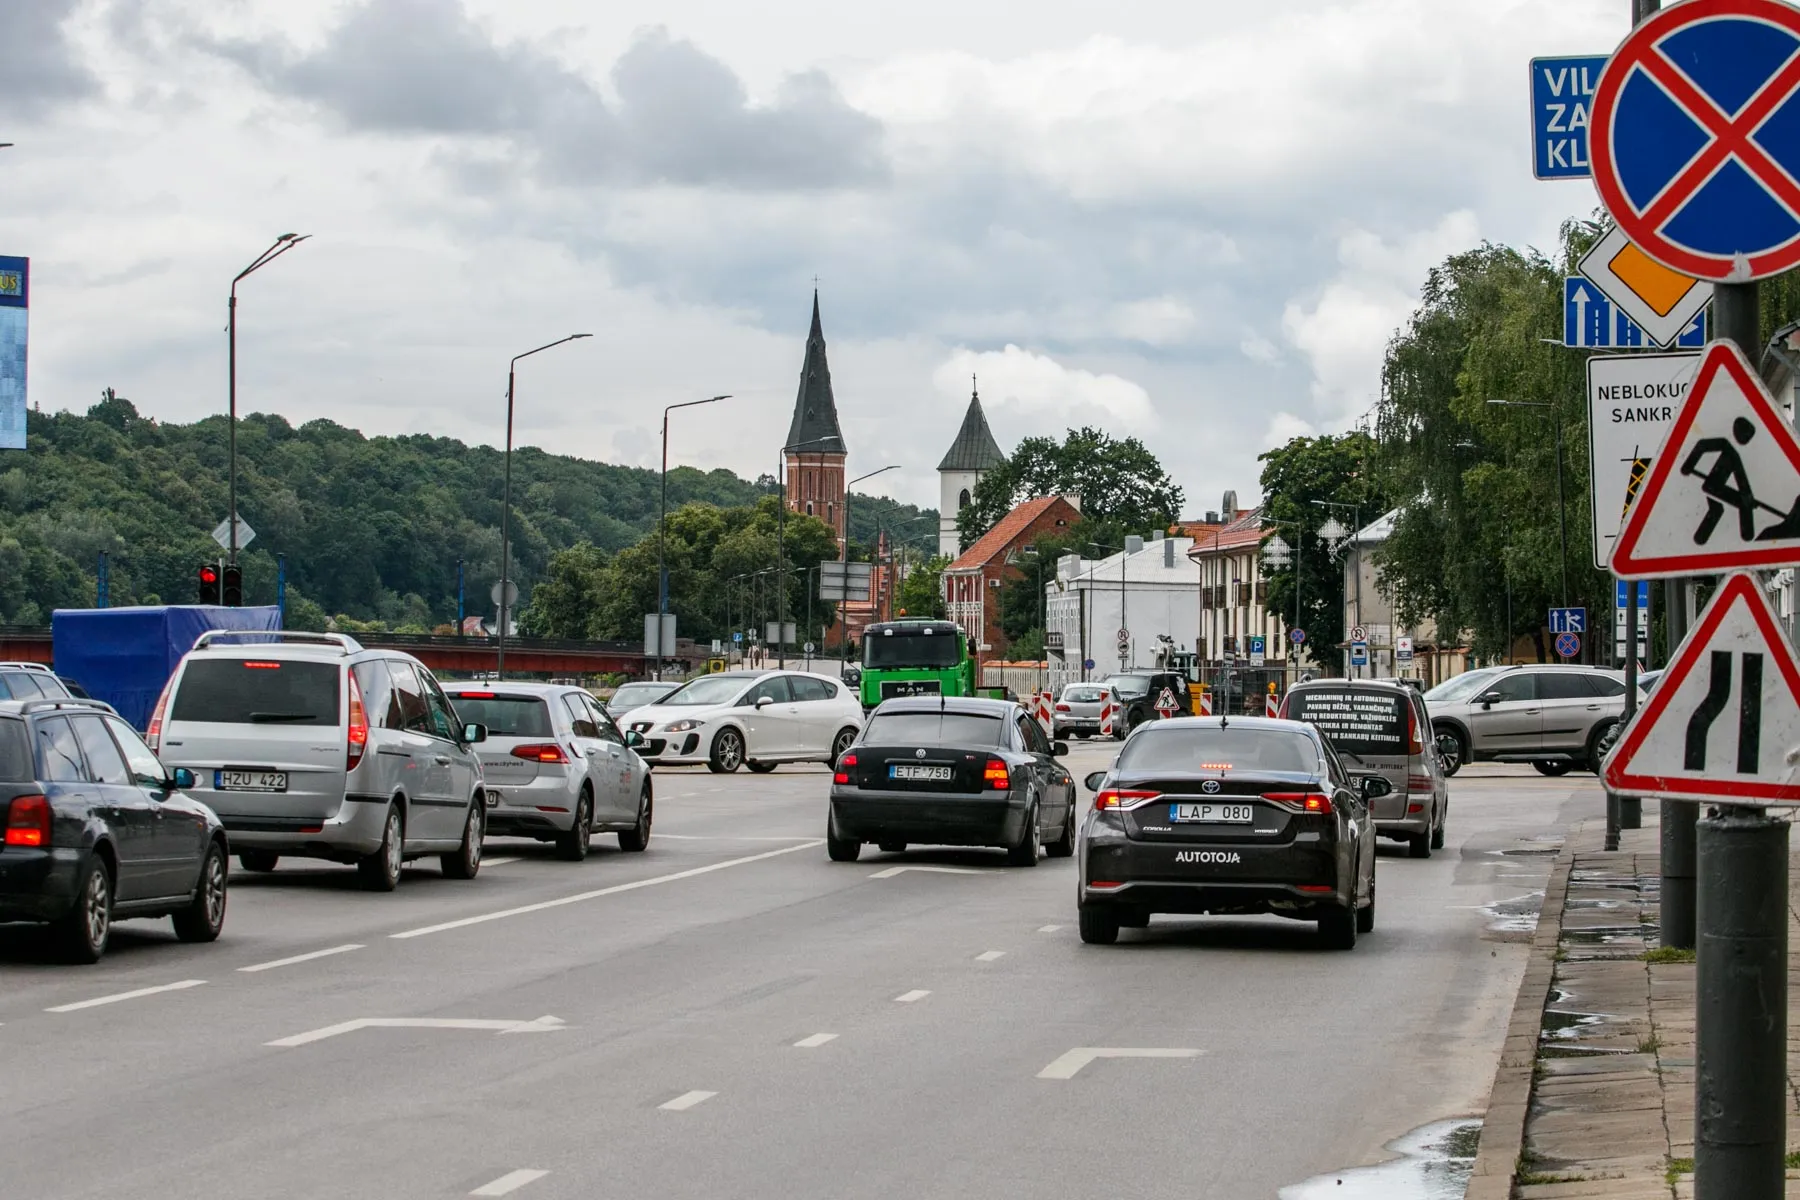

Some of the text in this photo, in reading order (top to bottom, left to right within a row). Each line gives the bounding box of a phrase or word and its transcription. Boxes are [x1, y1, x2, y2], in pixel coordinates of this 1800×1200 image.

[1543, 66, 1595, 97] VIL
[1545, 102, 1589, 132] ZA
[1547, 138, 1588, 169] KL
[1611, 405, 1677, 423] SANKR
[1350, 722, 1384, 731] REMONTAS
[1370, 734, 1401, 742] KEITIMAS
[896, 767, 949, 778] ETF 758
[223, 773, 285, 787] HZU 422
[1179, 805, 1250, 819] LAP 080
[1175, 851, 1241, 863] AUTOTOJA
